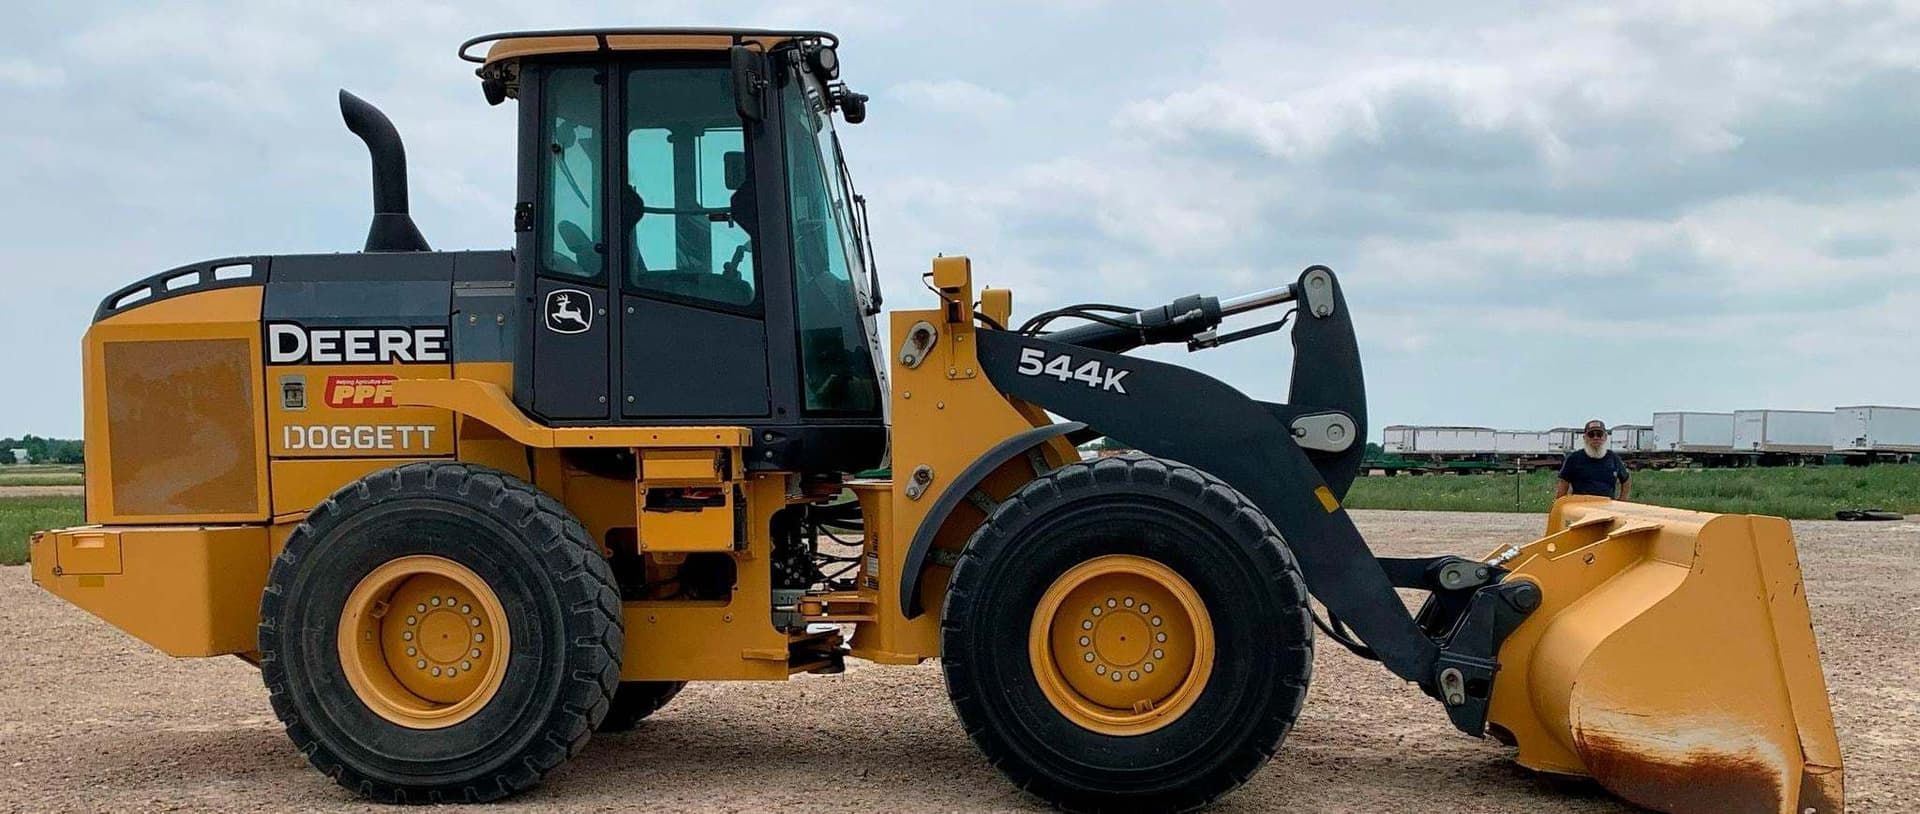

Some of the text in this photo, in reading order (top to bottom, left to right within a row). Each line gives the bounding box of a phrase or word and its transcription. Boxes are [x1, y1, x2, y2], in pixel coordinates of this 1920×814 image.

[269, 324, 446, 362] DEERE
[1018, 347, 1130, 394] 544K
[284, 425, 435, 449] DOGGETT
